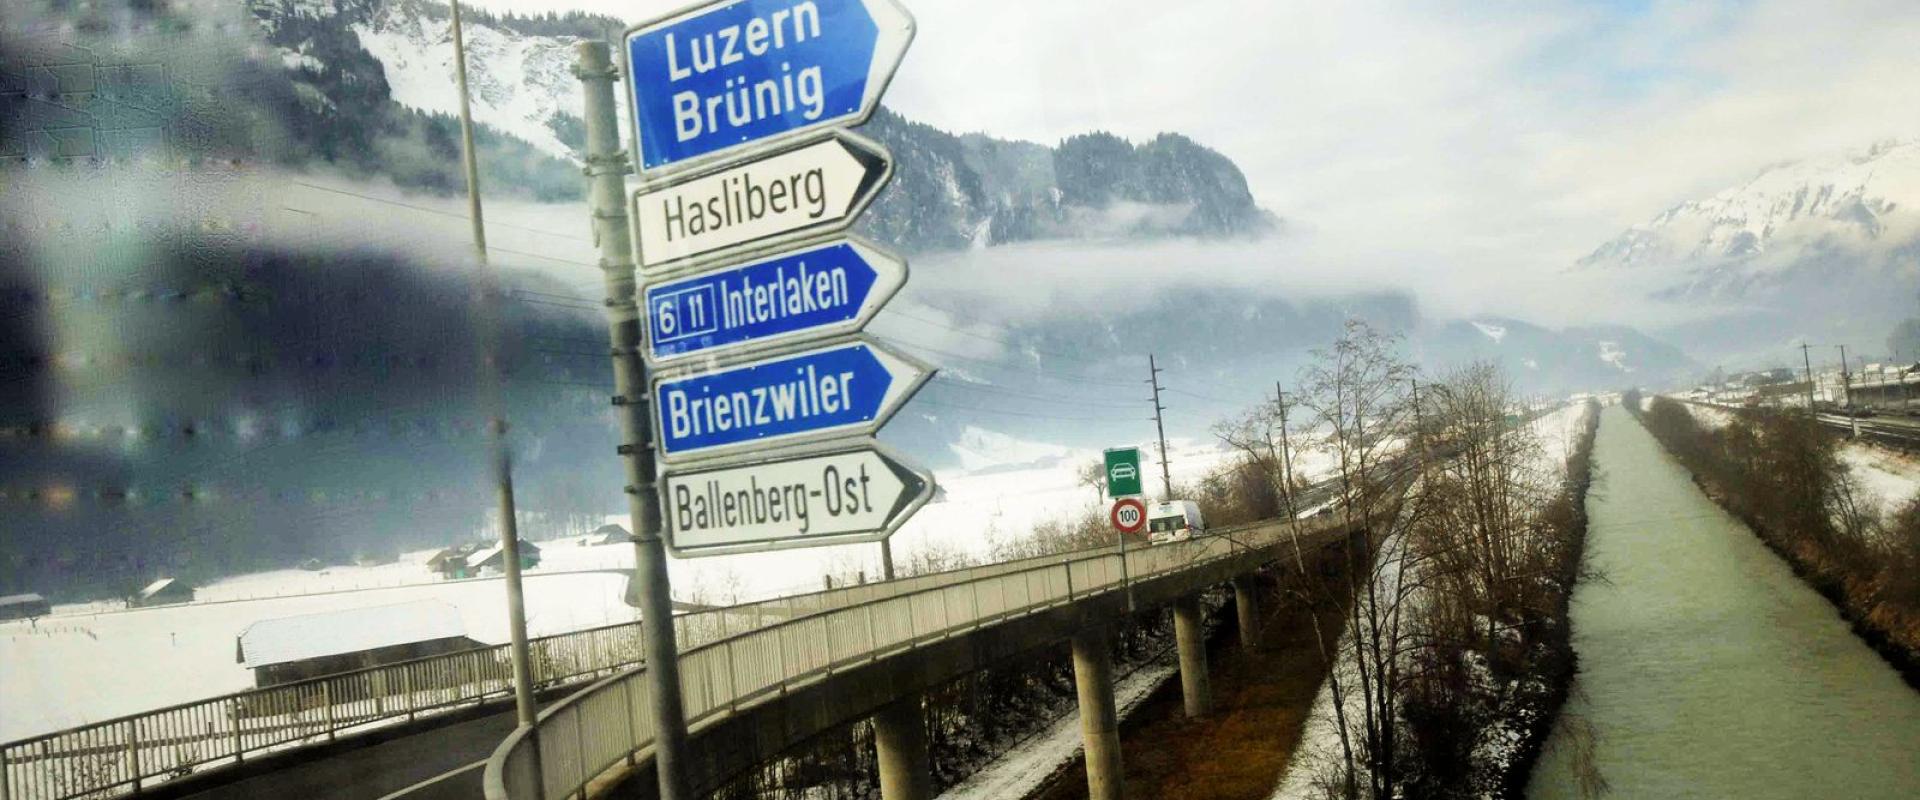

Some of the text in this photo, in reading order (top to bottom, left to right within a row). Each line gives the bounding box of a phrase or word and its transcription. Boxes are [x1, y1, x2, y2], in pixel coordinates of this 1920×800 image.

[665, 0, 820, 82] Luzern
[672, 62, 825, 142] Brünig
[663, 167, 826, 242] Hasliberg
[658, 261, 848, 334] 6 11 Interlaken
[668, 365, 854, 439] Brienzwiler
[676, 463, 873, 533] Ballenberg-Ost
[1120, 509, 1138, 522] 100
